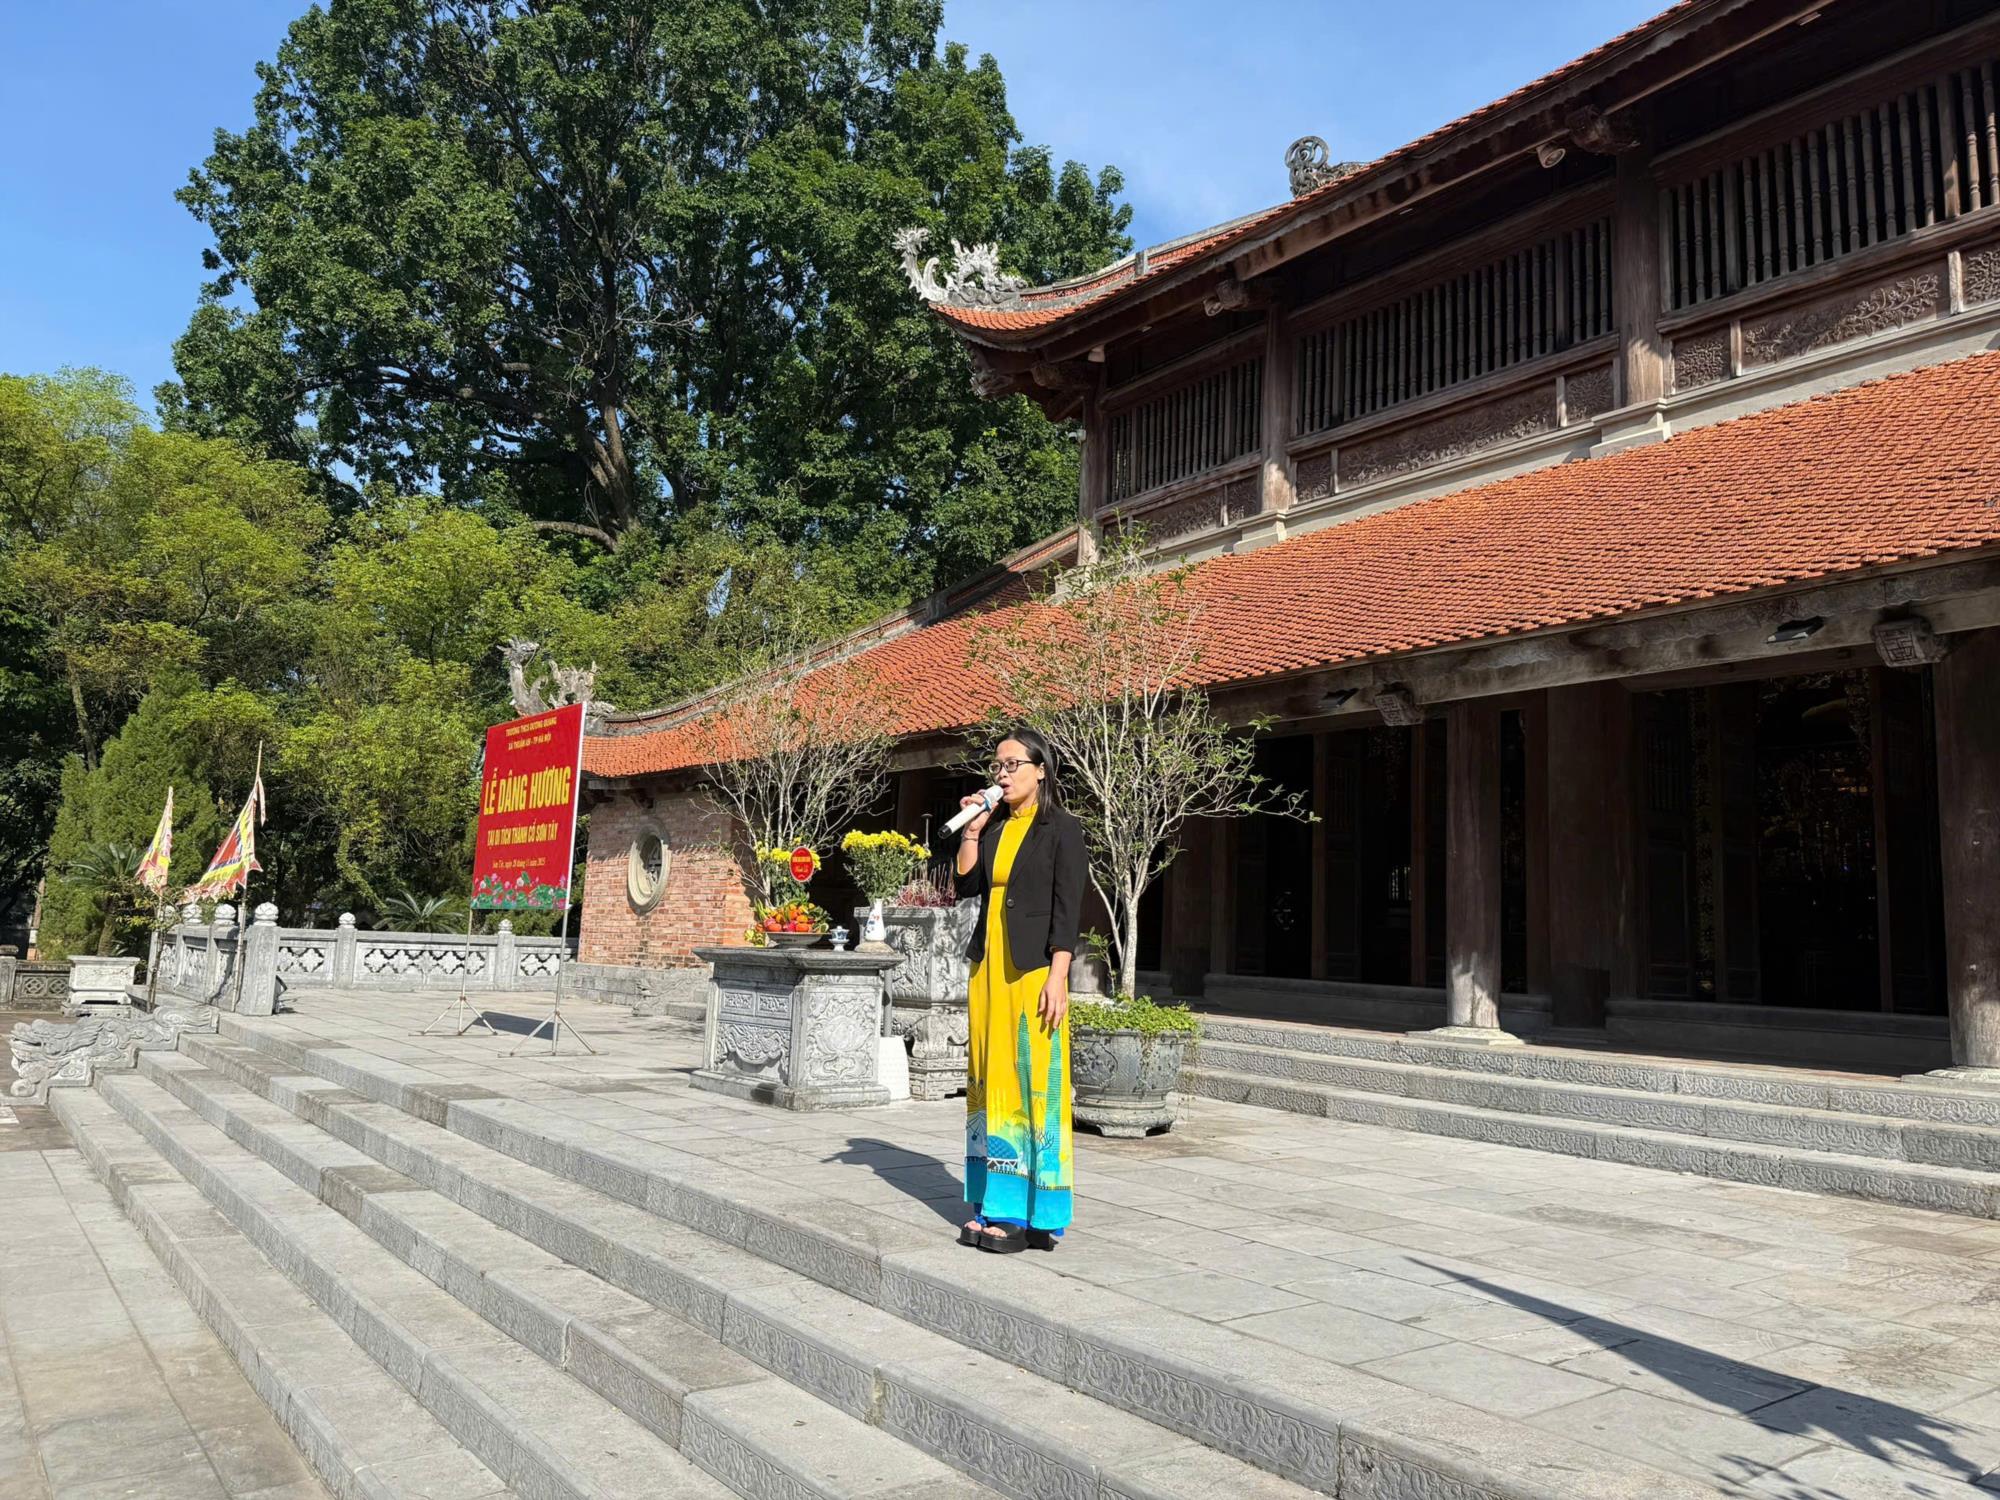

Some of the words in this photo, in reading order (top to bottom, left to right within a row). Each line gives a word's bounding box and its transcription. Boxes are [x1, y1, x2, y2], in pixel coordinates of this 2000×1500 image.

[520, 723, 530, 733] THCS
[484, 767, 498, 815] LỄ
[498, 769, 528, 813] DÂNG
[529, 764, 571, 809] HƯƠNG
[488, 830, 496, 850] TẠI
[495, 829, 501, 846] DI
[500, 825, 512, 846] TÍCH
[512, 824, 528, 844] THÀNH
[528, 818, 536, 843] CỔ
[536, 823, 548, 842] SƠN
[548, 819, 558, 841] TÂY
